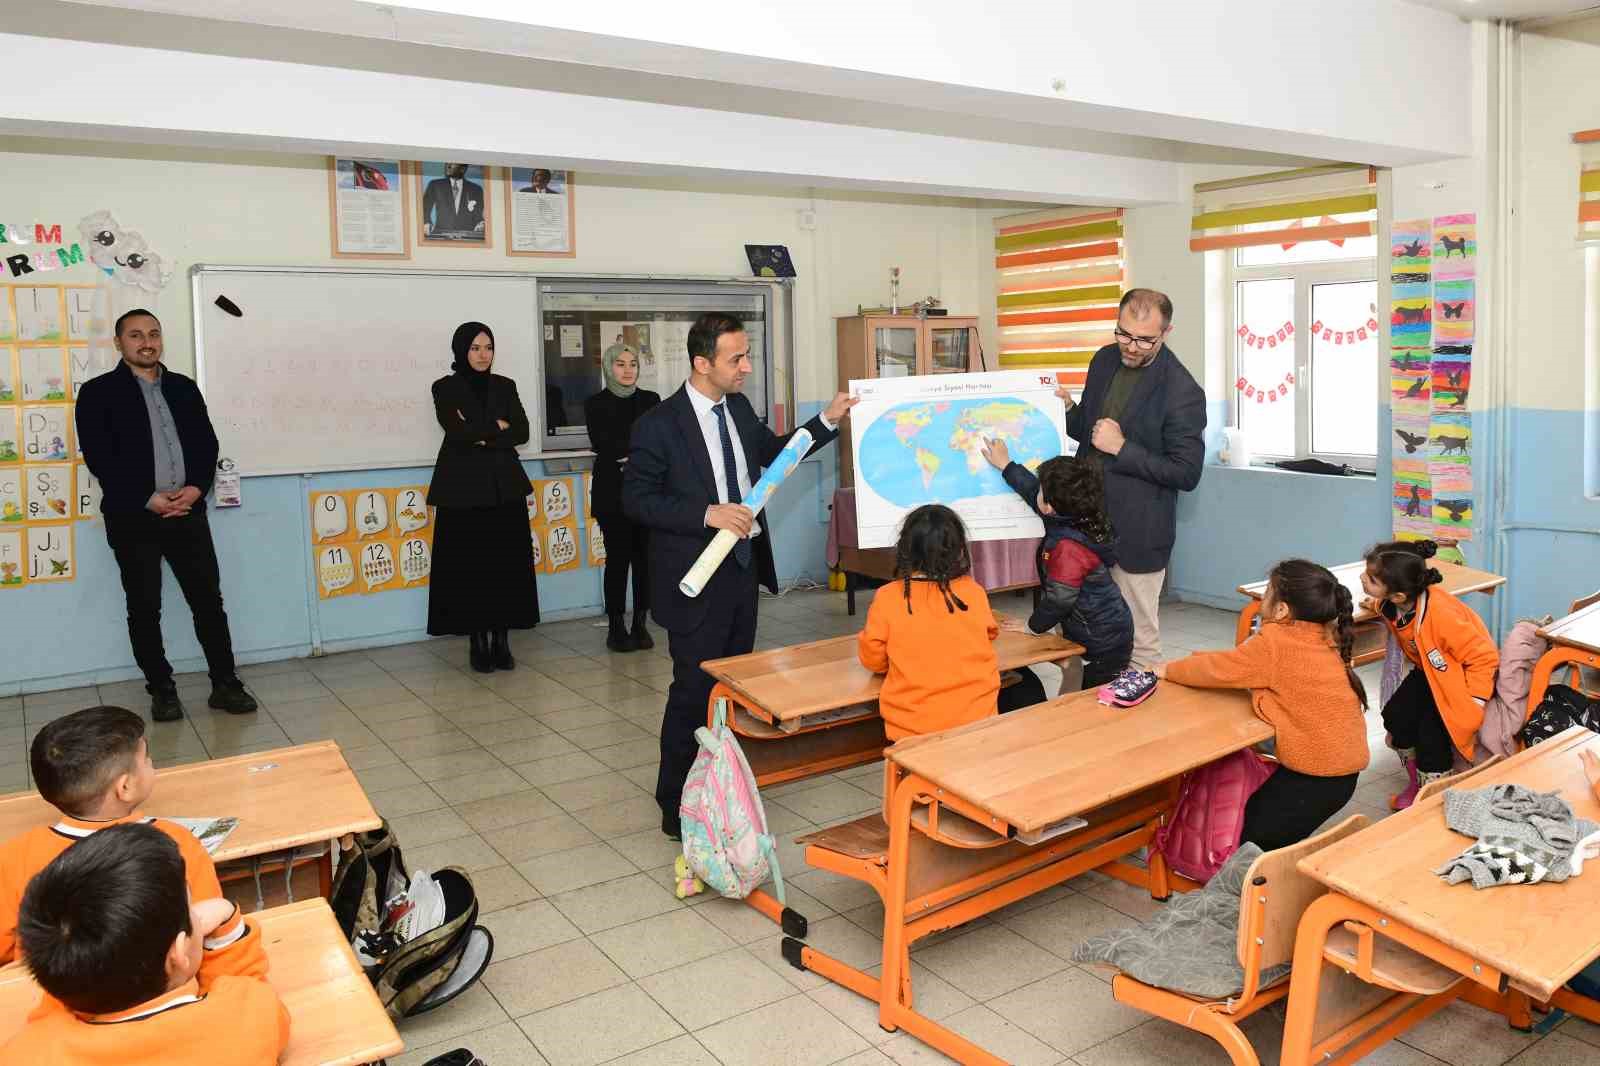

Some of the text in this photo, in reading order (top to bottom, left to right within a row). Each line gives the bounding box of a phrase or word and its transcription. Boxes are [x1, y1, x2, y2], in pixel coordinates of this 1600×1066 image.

[29, 413, 47, 432] D
[27, 434, 39, 454] d
[37, 472, 50, 496] Ş
[551, 482, 562, 498] 6
[325, 495, 337, 512] 0
[367, 493, 375, 510] 1
[405, 490, 417, 507] 2
[29, 501, 39, 517] ş
[37, 531, 51, 552] J
[552, 526, 568, 544] 17
[328, 548, 343, 565] 11
[367, 543, 385, 561] 12
[406, 540, 424, 557] 13
[30, 554, 38, 578] j
